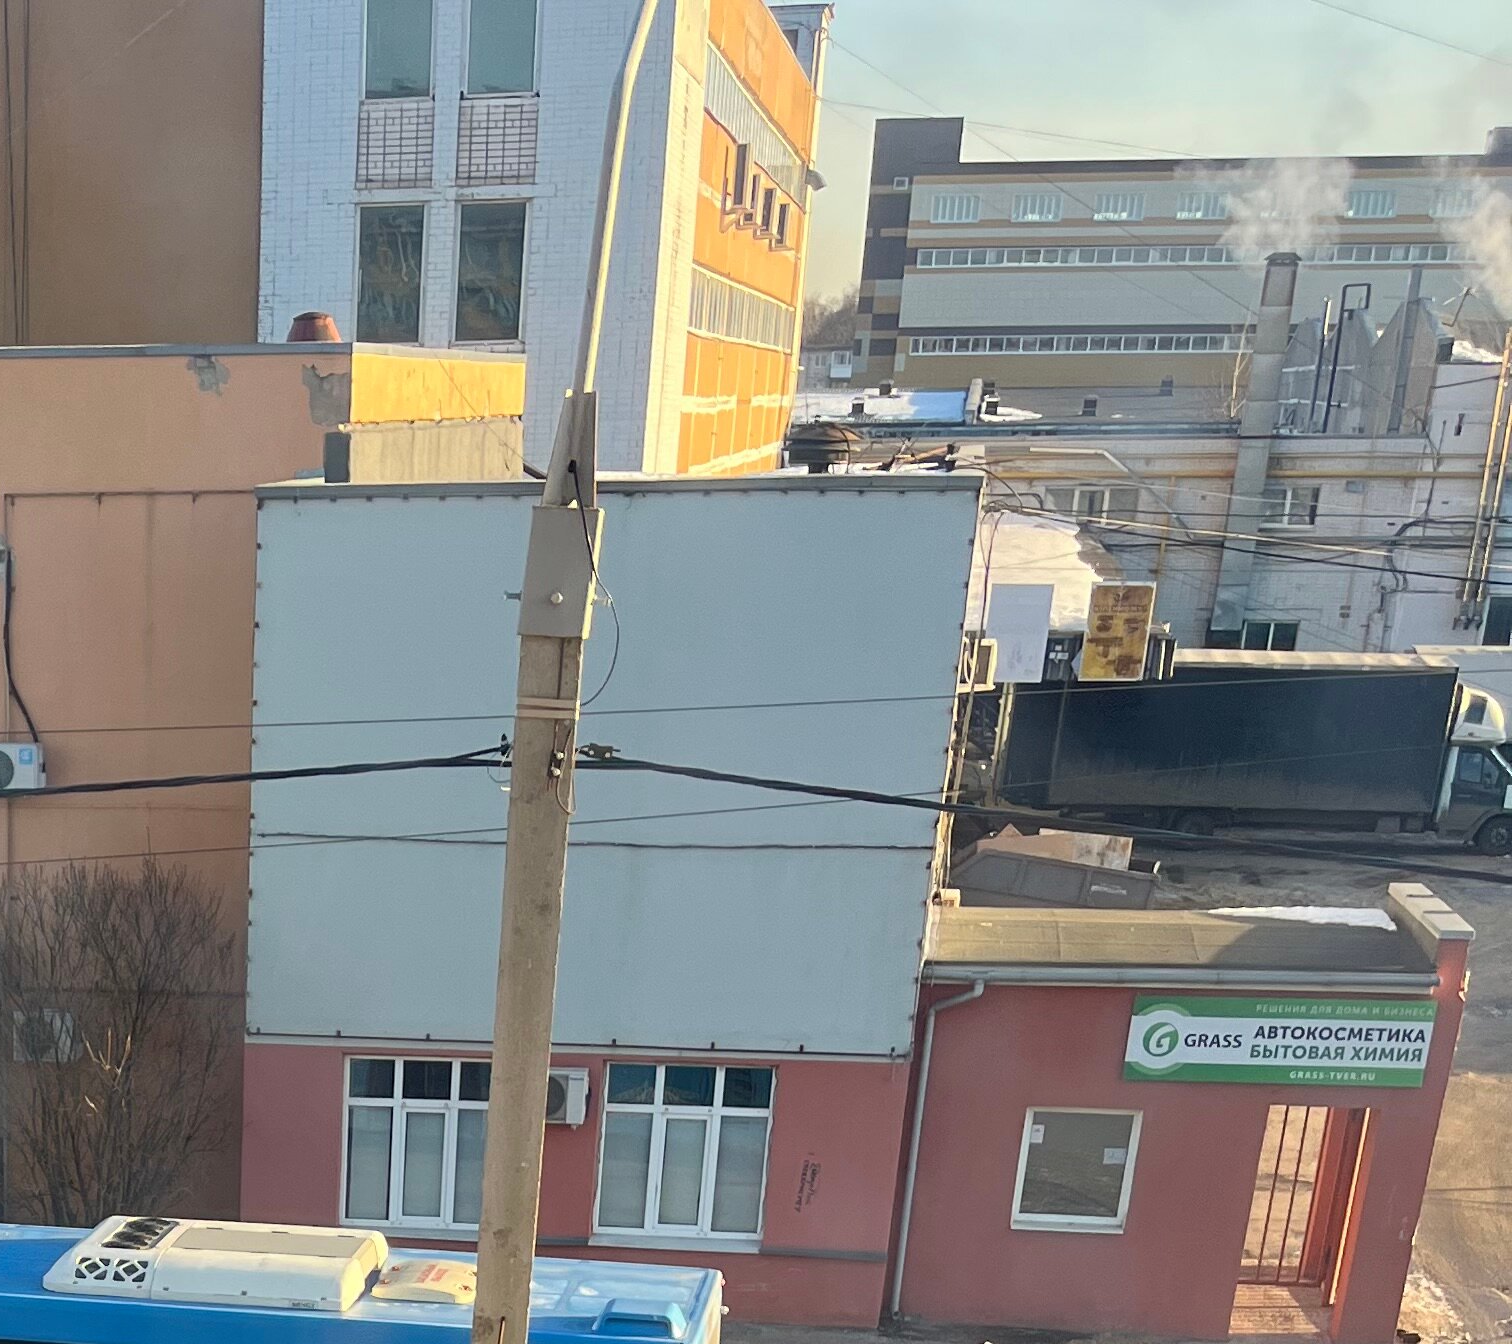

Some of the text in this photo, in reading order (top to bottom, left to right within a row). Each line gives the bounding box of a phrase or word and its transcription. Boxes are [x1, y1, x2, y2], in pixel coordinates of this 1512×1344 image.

[1256, 1004, 1434, 1017] РЕШЕНИЯ ДЛЯ ДОМА И БИЗНЕСА
[1184, 1033, 1243, 1049] GRASS
[1253, 1025, 1426, 1043] АВТОКОСМЕТИКА
[1249, 1044, 1423, 1062] БЫТОВАЯ ХИМИЯ
[1289, 1070, 1376, 1081] GRASS-TVER.RU
